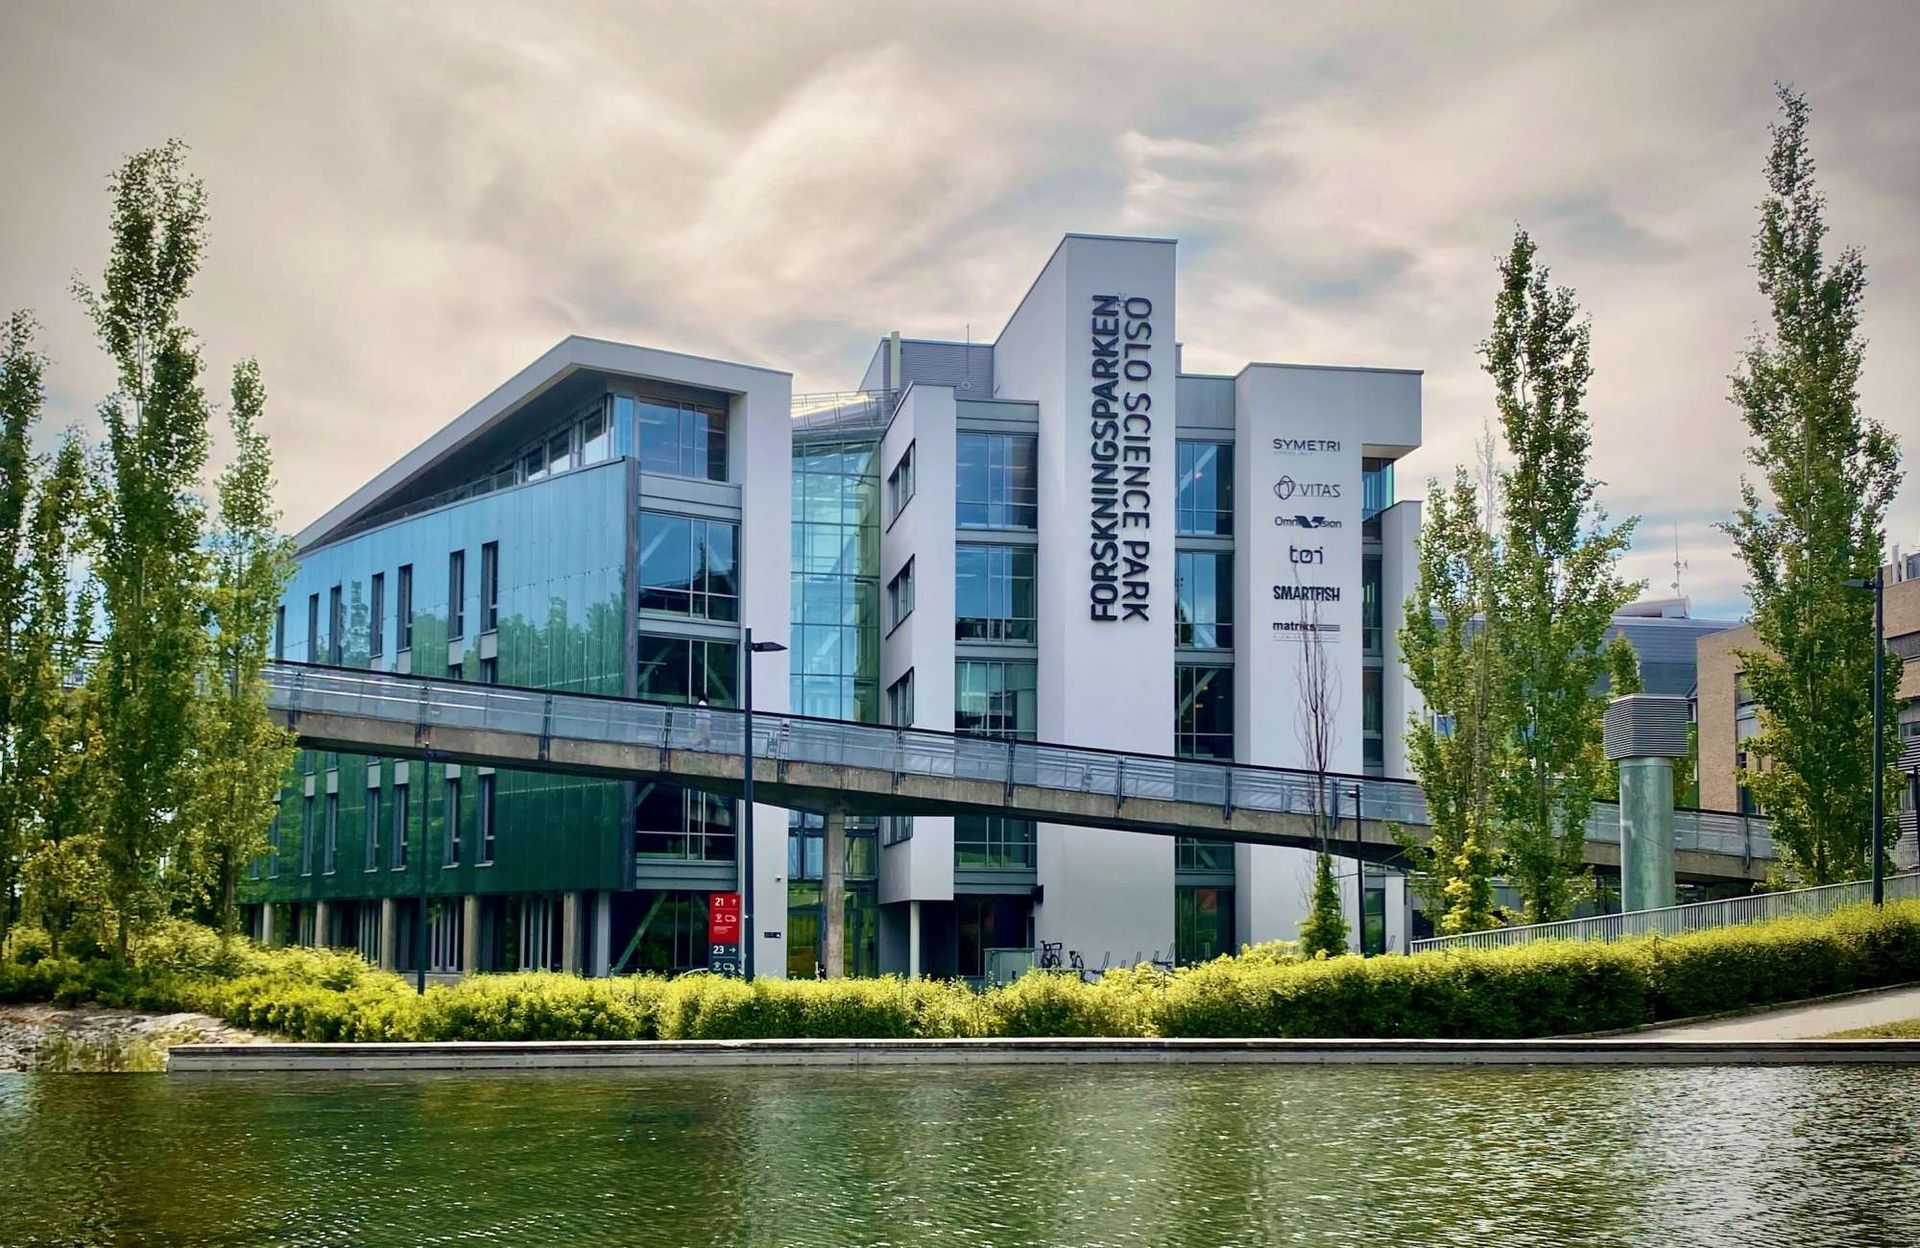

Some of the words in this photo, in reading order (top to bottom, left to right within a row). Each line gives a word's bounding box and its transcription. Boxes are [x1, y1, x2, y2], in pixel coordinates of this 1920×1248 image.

[1123, 297, 1153, 382] OSLO
[1272, 438, 1341, 452] SYMETRI
[1091, 294, 1120, 622] FORSKNINGSPARKEN
[1122, 391, 1152, 529] SCIENCE
[1299, 483, 1341, 498] VITAS
[1274, 515, 1342, 529] OmnVsion
[1121, 540, 1151, 622] PARK
[1273, 585, 1341, 602] SMARTFISH
[714, 897, 725, 907] 21
[712, 945, 725, 955] 23
